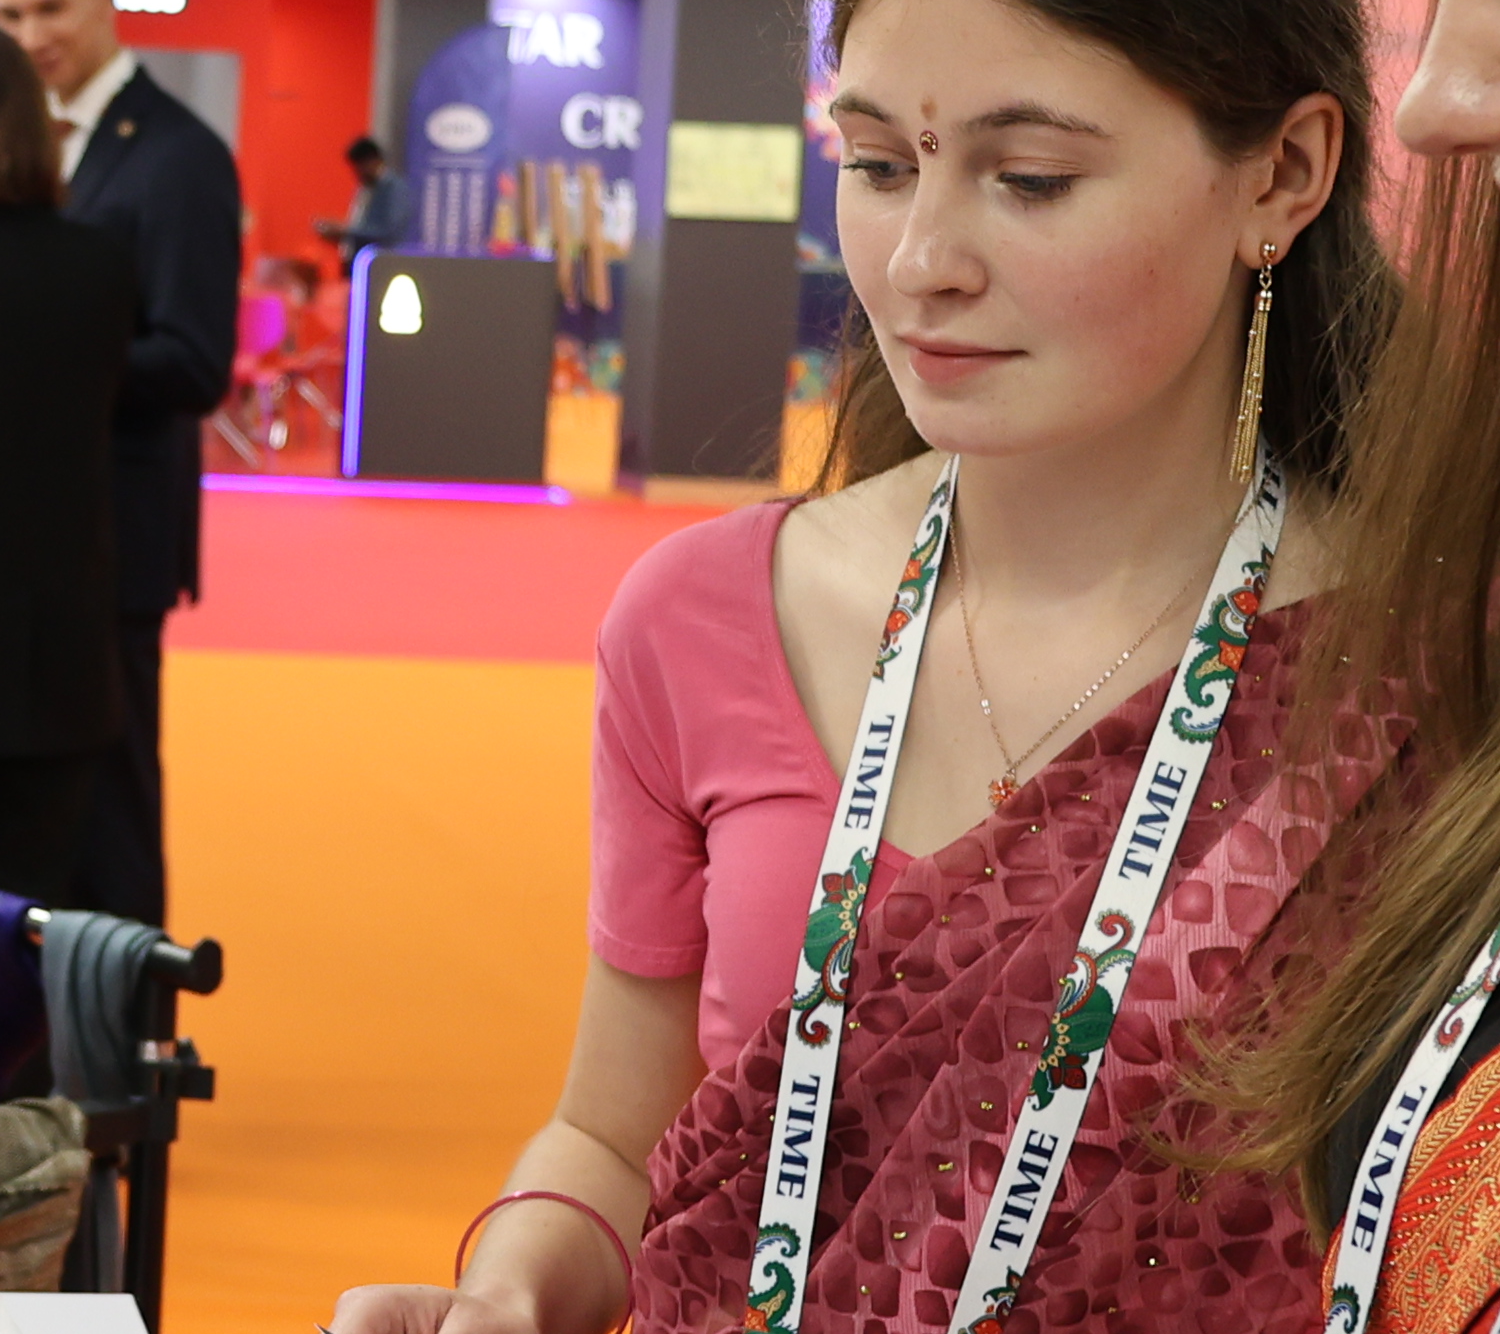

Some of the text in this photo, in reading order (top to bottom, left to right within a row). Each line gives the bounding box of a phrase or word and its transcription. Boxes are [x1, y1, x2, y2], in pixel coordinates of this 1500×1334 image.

[843, 713, 895, 831] TIME
[1119, 760, 1187, 879] TIME
[776, 1074, 819, 1202] TIME
[990, 1129, 1058, 1253] TIME
[1350, 1084, 1428, 1256] TIME
